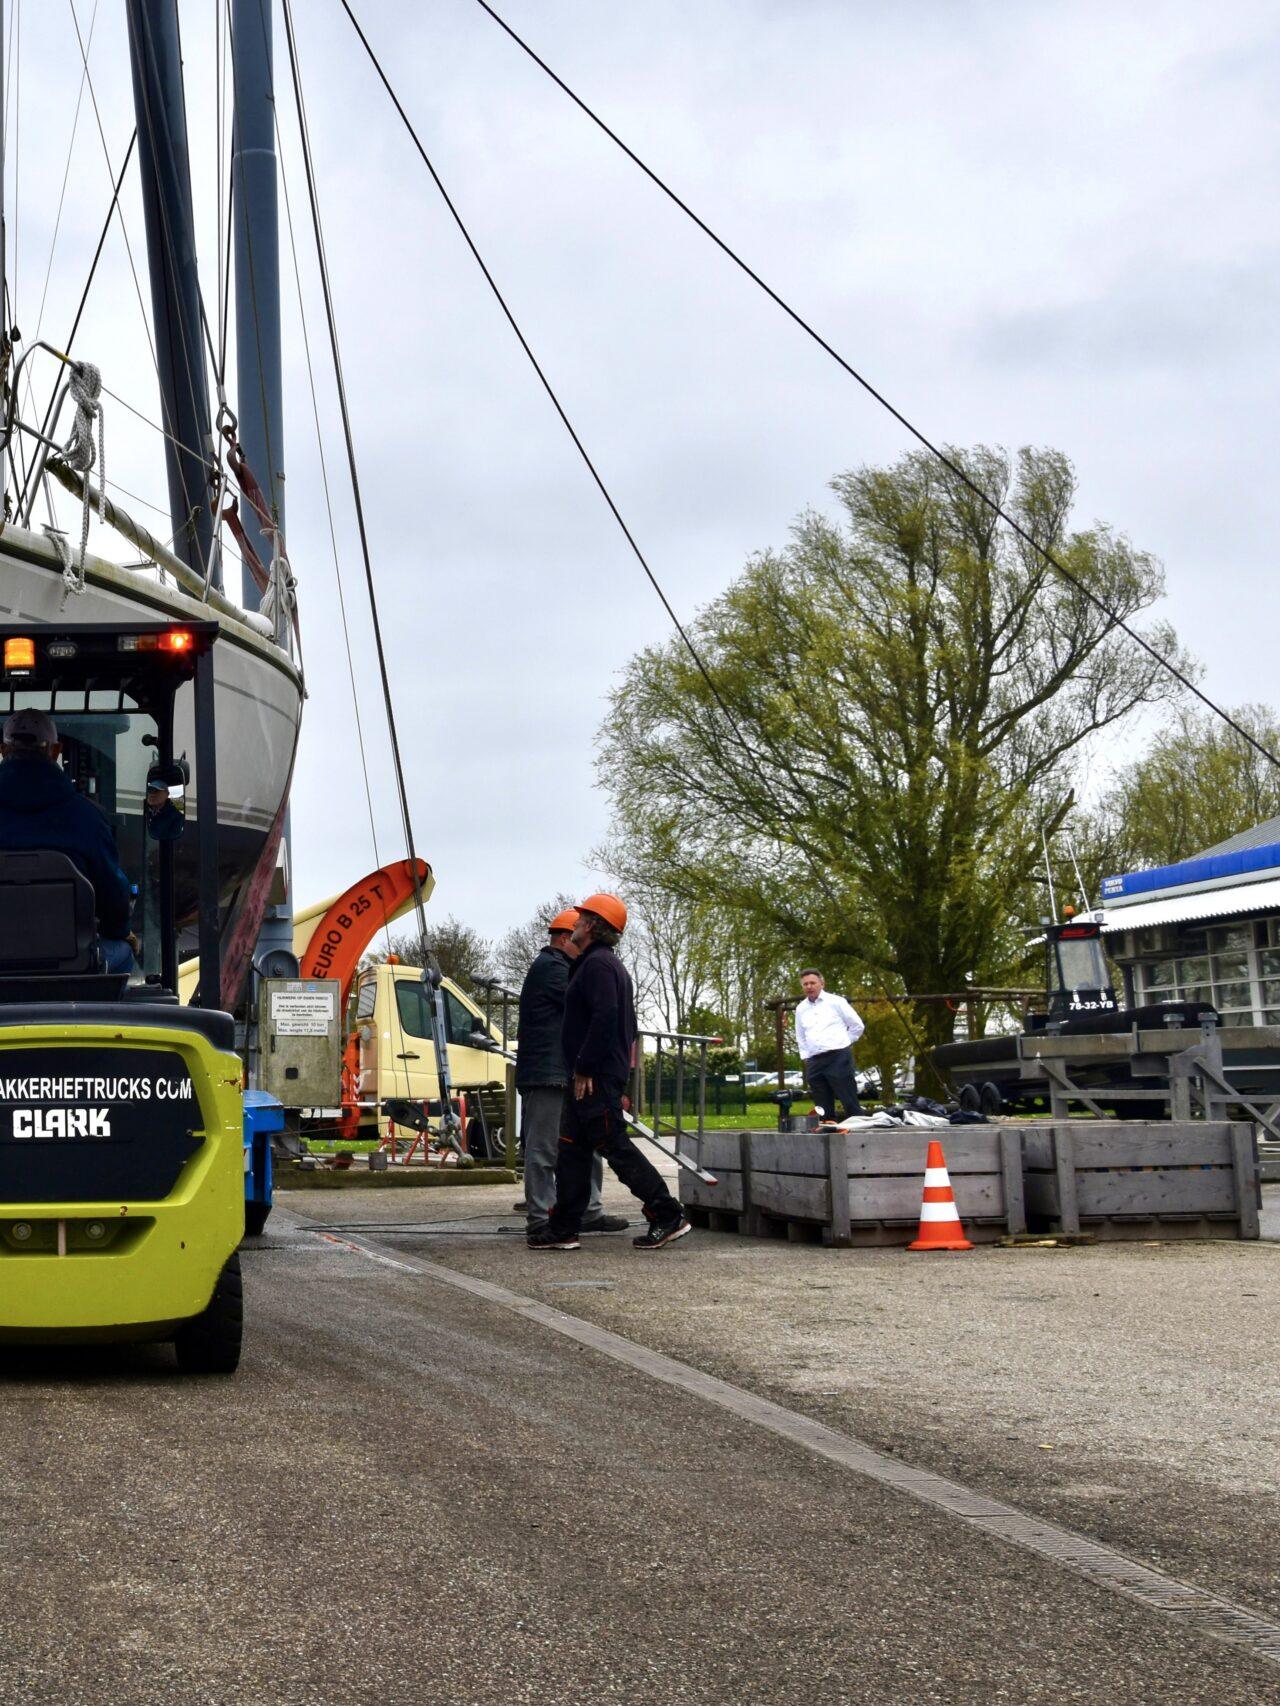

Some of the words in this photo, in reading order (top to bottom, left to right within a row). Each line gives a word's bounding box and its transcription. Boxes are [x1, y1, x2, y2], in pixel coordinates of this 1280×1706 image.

[312, 930, 342, 978] EURO
[337, 914, 352, 929] B
[350, 895, 371, 916] 25
[370, 885, 383, 900] T
[13, 1108, 111, 1138] CLARK
